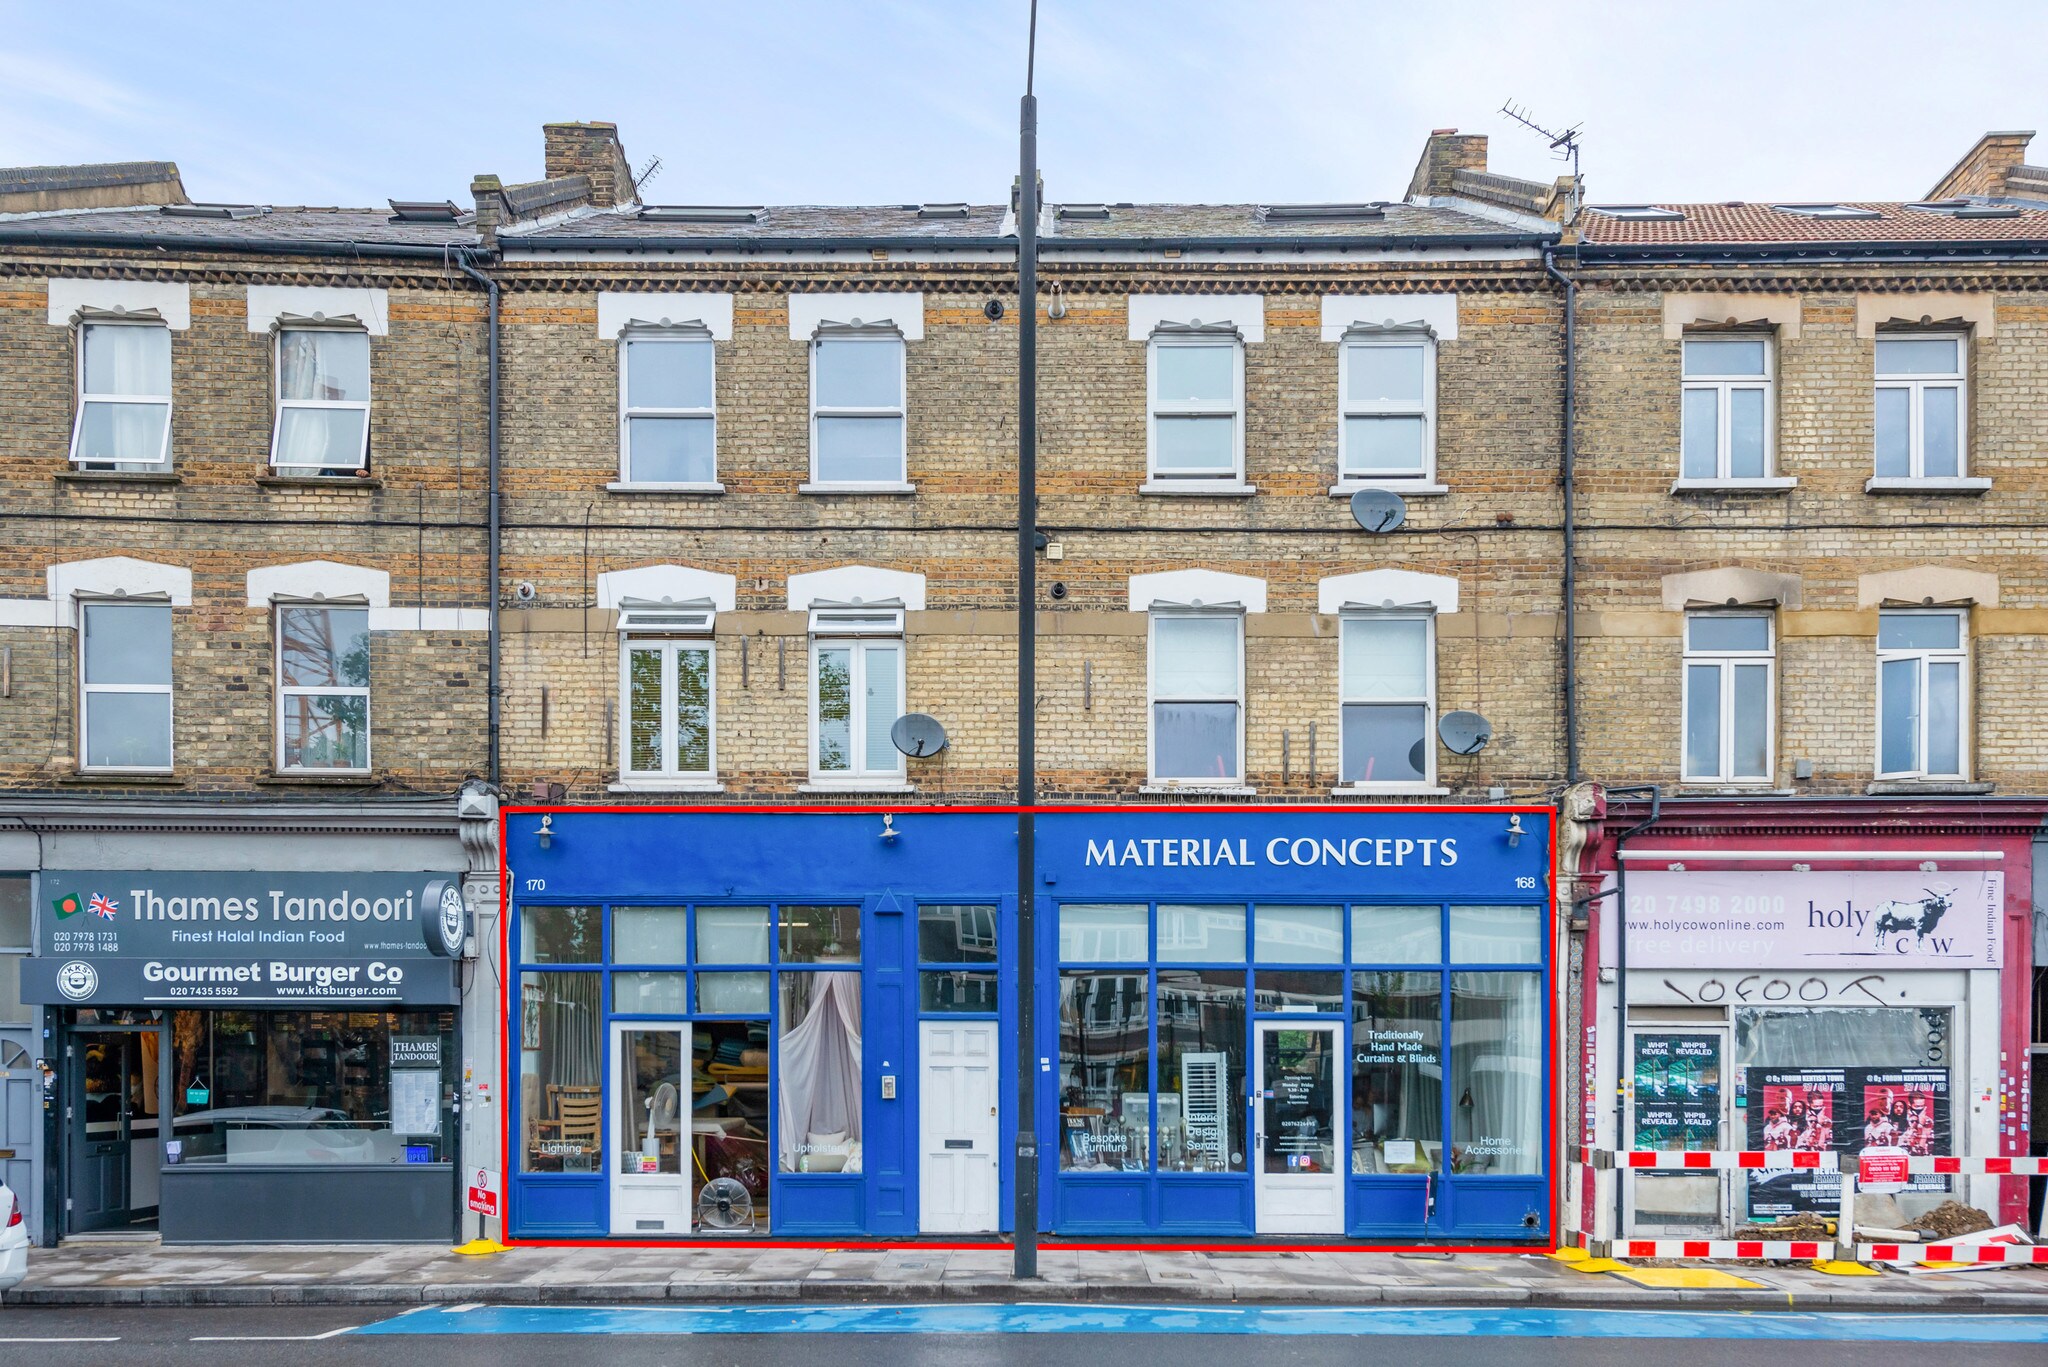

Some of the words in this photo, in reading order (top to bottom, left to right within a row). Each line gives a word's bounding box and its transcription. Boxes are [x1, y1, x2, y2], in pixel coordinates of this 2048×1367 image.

[1085, 839, 1256, 866] MATERIAL
[1266, 838, 1458, 866] CONCEPTS
[526, 879, 545, 891] 170
[1515, 877, 1535, 889] 168
[1987, 879, 1997, 900] Fine
[130, 889, 259, 921] Thames
[268, 889, 413, 921] Tandoori
[1667, 895, 1720, 914] 7498
[1731, 895, 1785, 914] 2000
[1808, 900, 1870, 936] holy
[1987, 904, 1997, 935] Indian
[54, 932, 70, 941] 020
[73, 932, 94, 941] 7978
[98, 932, 117, 941] 1731
[172, 930, 213, 942] Finest
[217, 930, 254, 942] Halal
[259, 930, 304, 943] Indian
[309, 930, 345, 943] Food
[54, 943, 70, 952] 020
[74, 943, 94, 952] 7978
[98, 943, 118, 952] 1488
[1627, 934, 1672, 953] free
[1680, 934, 1775, 957] delivery
[1987, 938, 1997, 963] Food
[67, 965, 88, 974] KKS
[143, 962, 261, 982] Gourmet
[269, 962, 360, 987] Burger
[367, 962, 403, 984] Co
[170, 987, 187, 996] 020
[190, 987, 213, 996] 7435
[215, 987, 238, 996] 5592
[276, 986, 397, 997] www.kksburger.com
[1368, 1030, 1424, 1042] Traditionally
[394, 1042, 437, 1051] THAMES
[1371, 1042, 1395, 1051] Hand
[1397, 1042, 1423, 1051] Made
[1676, 1048, 1713, 1056] REVEALED
[1357, 1053, 1394, 1063] Curtains
[1397, 1053, 1406, 1063] &
[1409, 1053, 1437, 1063] Blinds
[1684, 1118, 1712, 1126] VEALED
[1083, 1132, 1127, 1144] Bespoke
[1480, 1136, 1511, 1146] Home
[541, 1143, 582, 1155] Lighting
[1083, 1142, 1128, 1153] Furniture
[1187, 1140, 1225, 1151] Service
[477, 1190, 486, 1200] No
[470, 1200, 495, 1215] smoking
